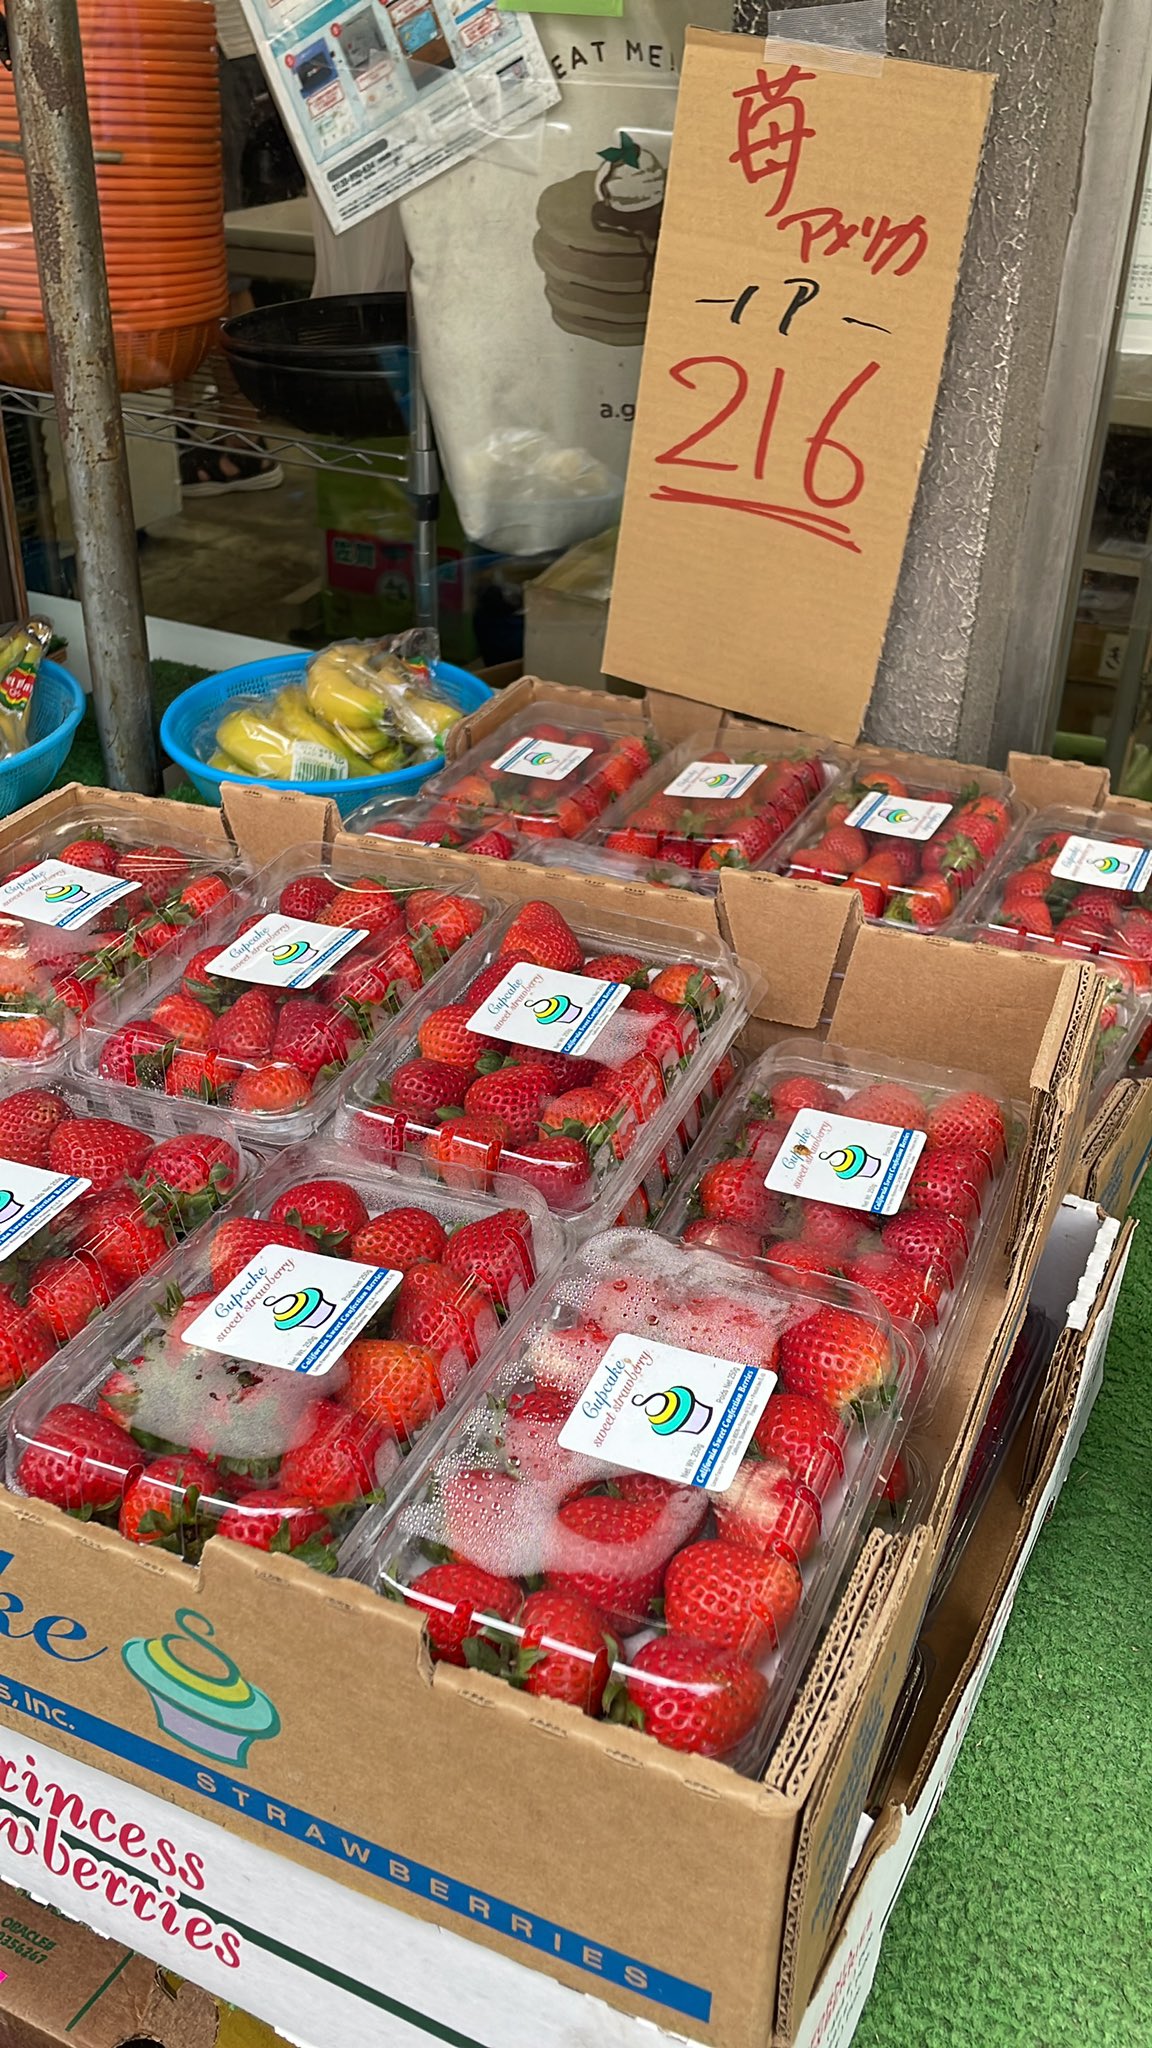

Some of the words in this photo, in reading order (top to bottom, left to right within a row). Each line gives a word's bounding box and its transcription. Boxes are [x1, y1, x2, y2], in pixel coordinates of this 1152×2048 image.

[551, 41, 606, 79] EAT
[626, 40, 675, 71] ME!
[729, 65, 816, 216] 苺
[777, 208, 928, 276] アメリカ
[655, 355, 880, 508] 216
[4, 870, 46, 894] Cupcake
[229, 927, 269, 959] Cupcake
[251, 923, 290, 957] strawberry
[488, 978, 523, 1015] Cupcake
[495, 1011, 511, 1031] sweet
[510, 973, 544, 1011] strawberry
[782, 1127, 811, 1169] Cupake
[793, 1163, 808, 1190] sweet
[872, 1186, 890, 1210] California
[888, 1147, 905, 1172] Confection
[214, 1265, 268, 1319] Cupcake
[217, 1311, 245, 1342] sweet
[245, 1257, 295, 1312] strawberry
[298, 1338, 331, 1369] California
[324, 1321, 344, 1338] Sweet
[338, 1291, 370, 1321] Confection
[363, 1270, 385, 1290] Berries
[582, 1358, 626, 1419] Cupcake
[593, 1411, 616, 1447] sweet
[615, 1349, 654, 1413] strawberry
[714, 1388, 729, 1404] Poids
[726, 1365, 741, 1379] 250g
[735, 1369, 755, 1393] Berries
[719, 1393, 745, 1428] Confection
[689, 1442, 704, 1458] 250g
[711, 1427, 728, 1447] Sweet
[694, 1447, 720, 1483] California
[24, 1691, 76, 1731] Inc.
[197, 1772, 649, 1989] STRAWBERRIES
